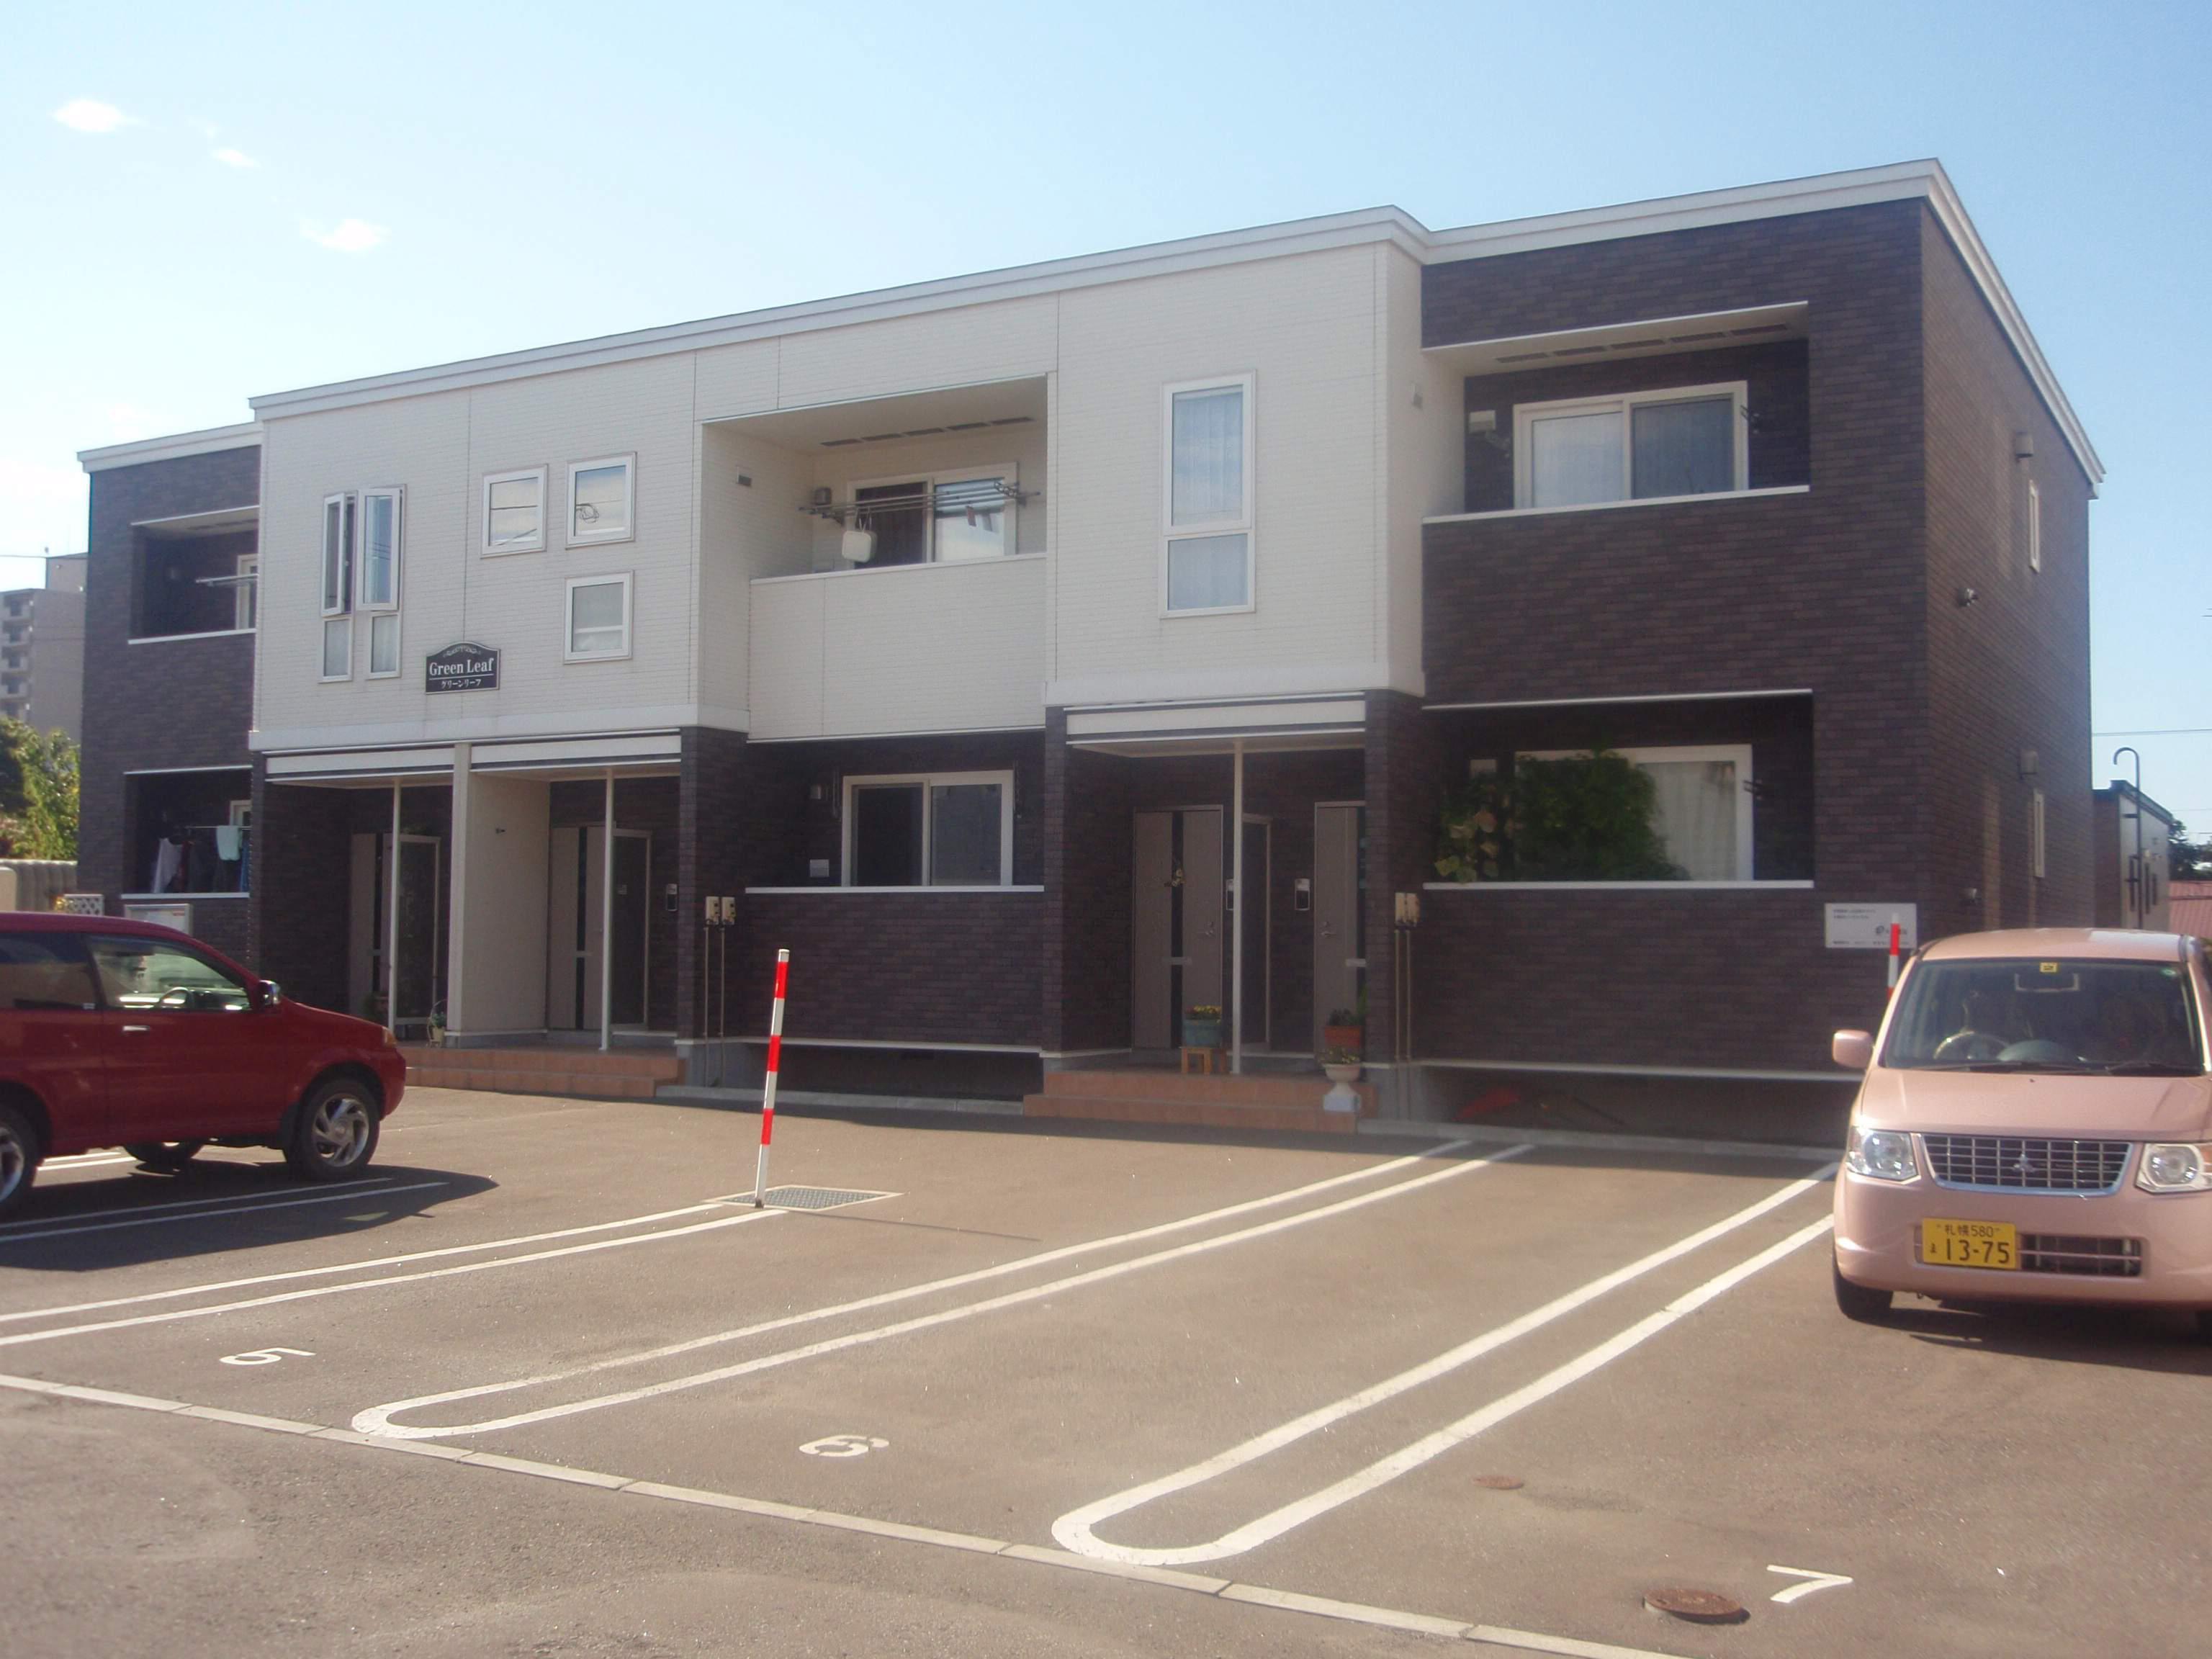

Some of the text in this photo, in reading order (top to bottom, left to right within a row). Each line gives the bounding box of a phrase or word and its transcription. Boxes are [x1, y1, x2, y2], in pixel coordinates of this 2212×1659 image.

[429, 657, 495, 676] Green Leaf
[1946, 1238, 2010, 1264] 13-75
[219, 1347, 317, 1365] 5
[799, 1434, 889, 1457] 6
[1766, 1564, 1853, 1604] 7
